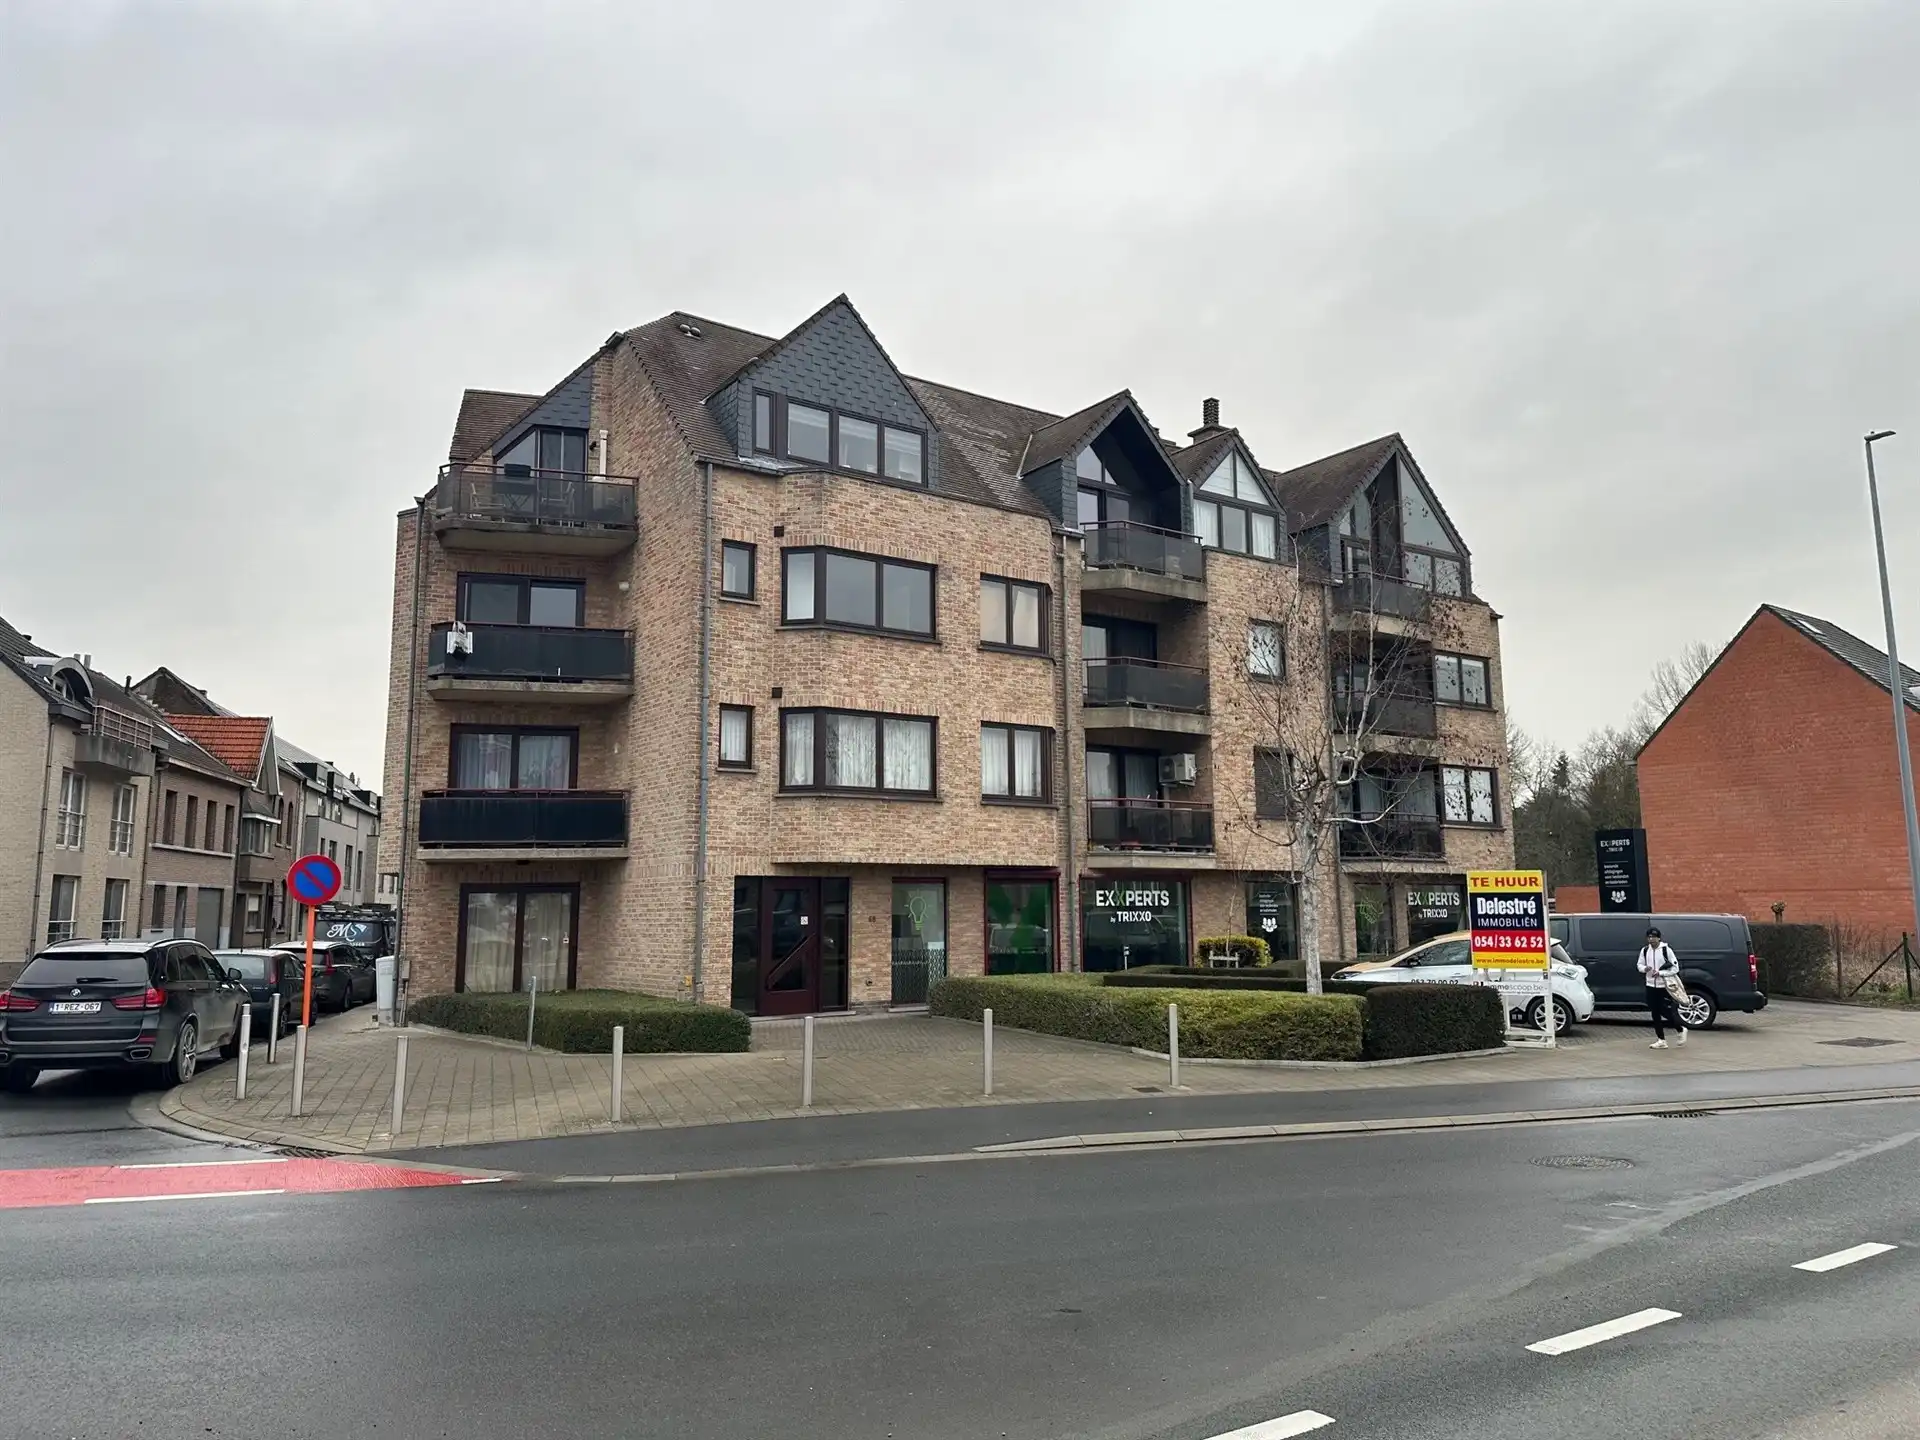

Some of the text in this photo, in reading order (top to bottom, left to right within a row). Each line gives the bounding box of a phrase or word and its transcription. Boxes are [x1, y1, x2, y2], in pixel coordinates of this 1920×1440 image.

[1470, 876, 1539, 887] TE HUUR
[1095, 890, 1170, 906] EXXPERTS
[1407, 892, 1460, 906] EXXPERTS
[1476, 896, 1537, 915] Delestré
[1117, 911, 1152, 922] TRIXXO
[1422, 908, 1448, 918] TRIXXO
[1478, 917, 1538, 927] IMMOBILIËN
[1474, 934, 1544, 948] 054/33 62 52
[1476, 957, 1545, 965] www.immodelestre.be
